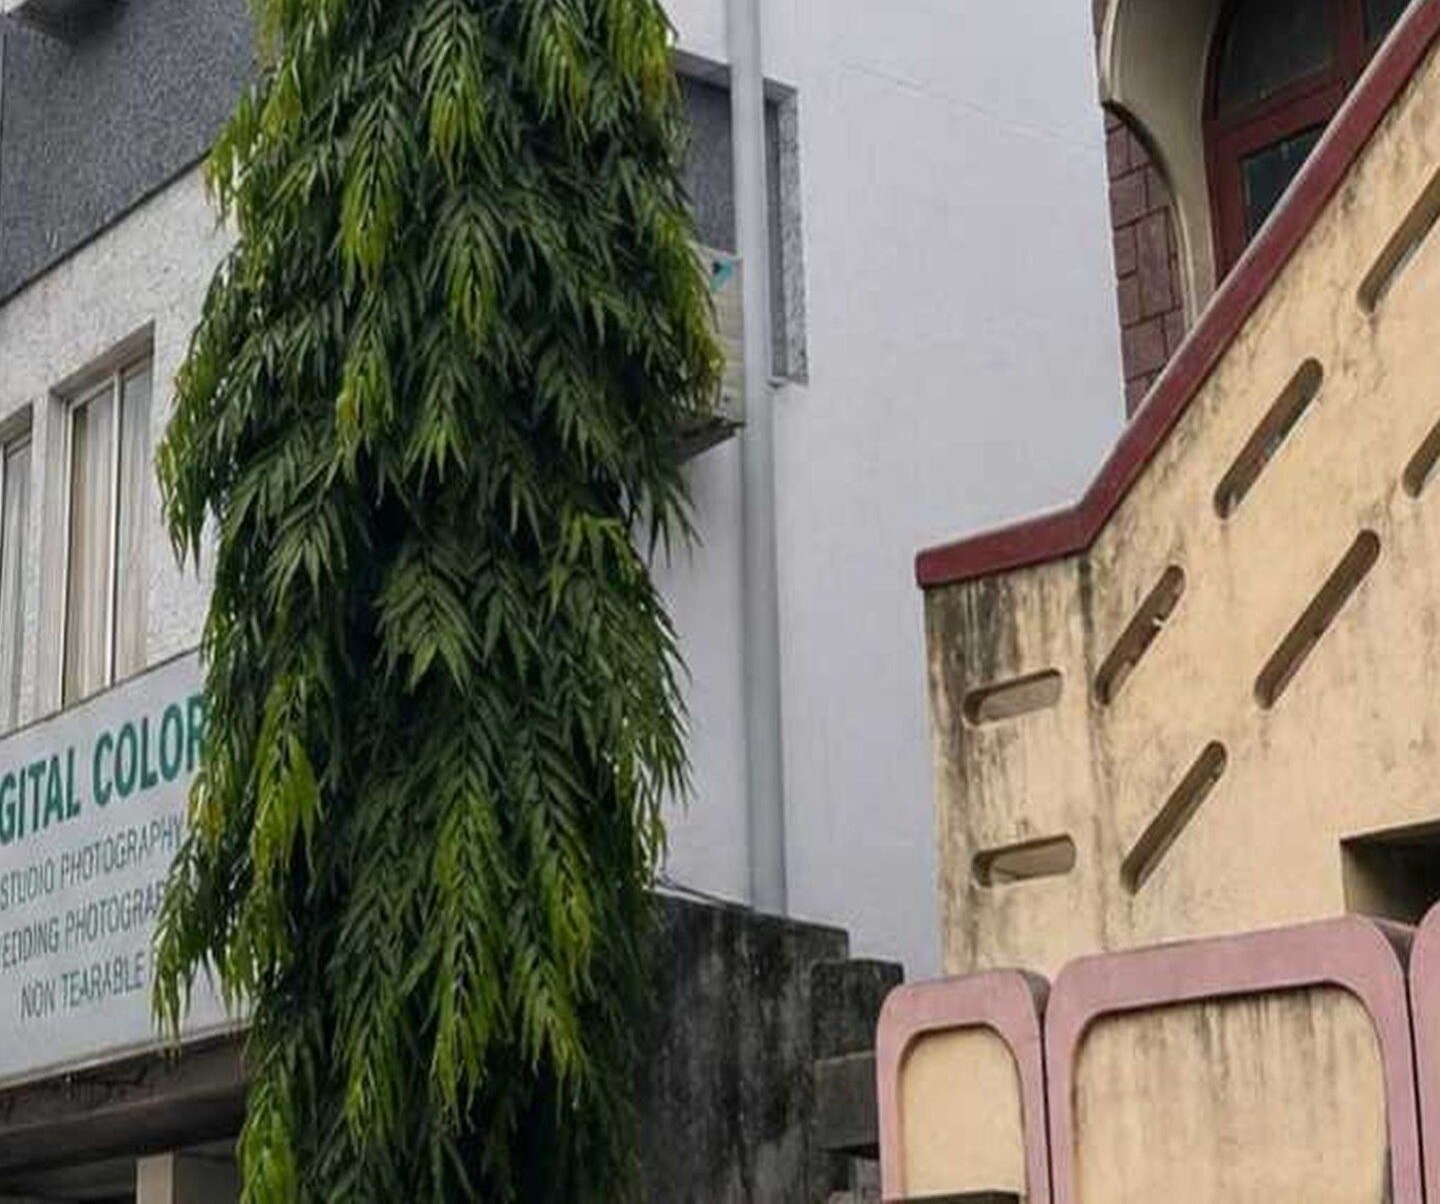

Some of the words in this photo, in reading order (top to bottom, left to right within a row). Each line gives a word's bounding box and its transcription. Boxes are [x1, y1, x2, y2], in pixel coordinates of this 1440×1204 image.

[0, 856, 55, 911] STUDIO
[61, 810, 184, 890] PHOTOGRAPHY
[64, 878, 166, 948] PHOTOGRAP
[20, 978, 58, 1020] NON
[62, 950, 146, 1008] TEARABLE
